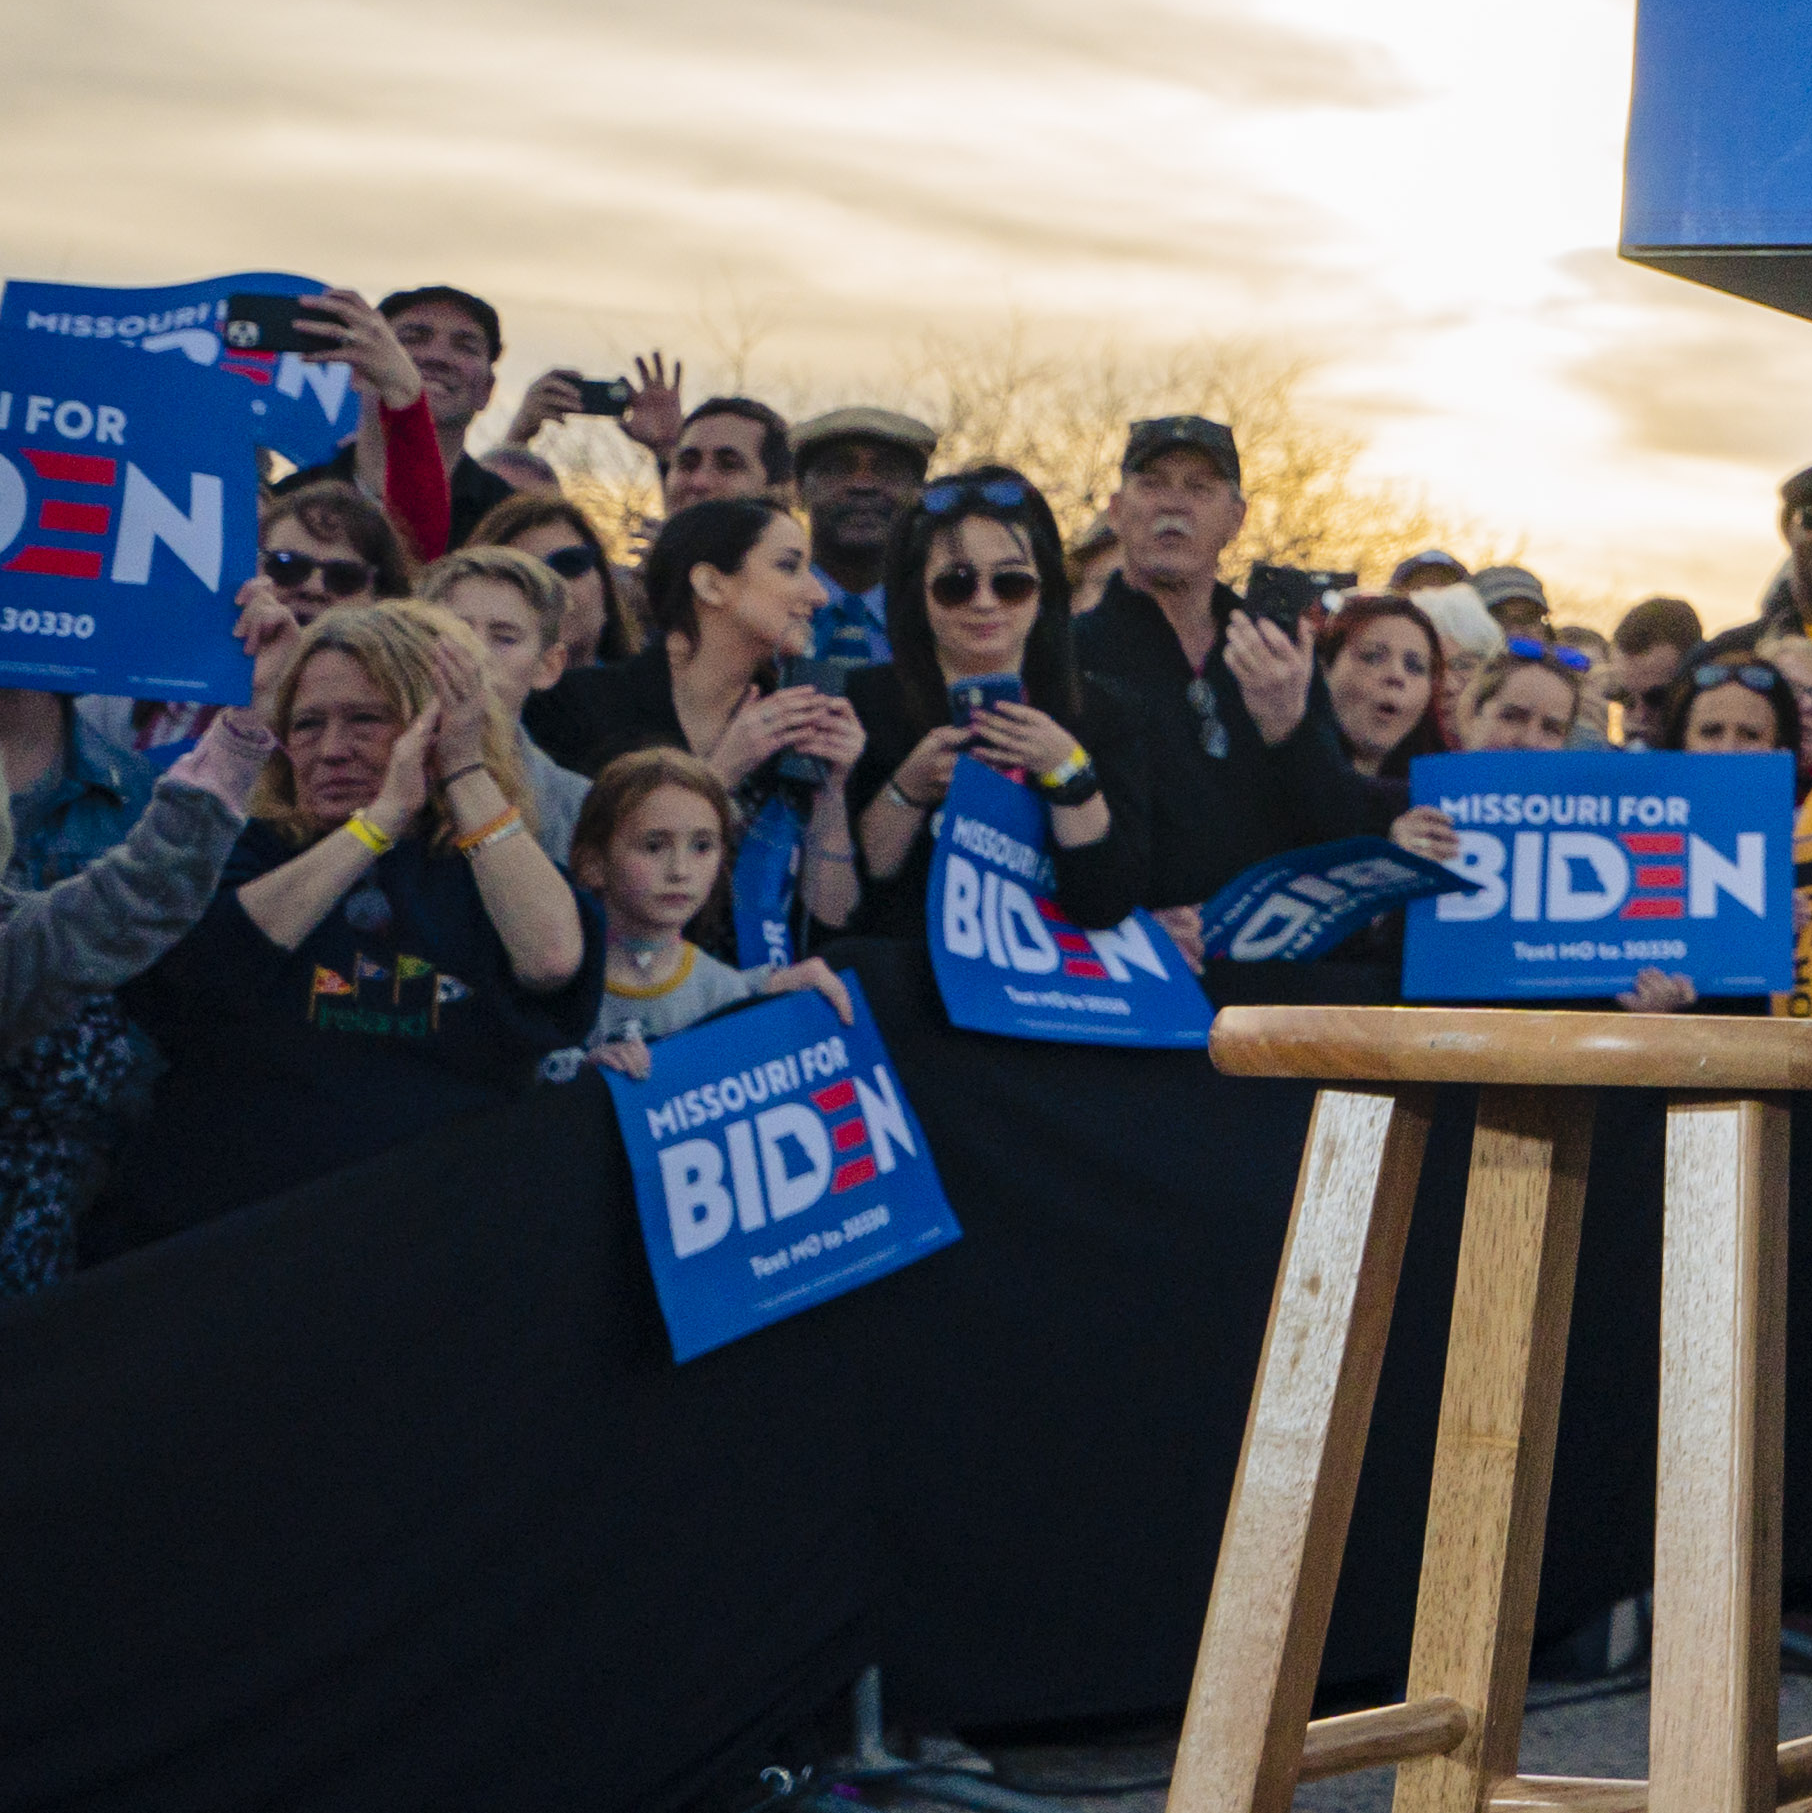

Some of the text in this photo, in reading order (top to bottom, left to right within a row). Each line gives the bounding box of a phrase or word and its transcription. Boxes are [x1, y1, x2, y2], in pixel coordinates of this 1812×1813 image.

[27, 301, 212, 339] MISSOURI
[25, 394, 128, 446] FOR
[0, 605, 96, 640] 30330
[1438, 794, 1689, 826] MISSOURI FOR
[1434, 830, 1767, 922] BIDEN
[942, 852, 1171, 984] BIDEN
[646, 1036, 849, 1140] MISSOURI FOR
[658, 1064, 918, 1260] BIDEN
